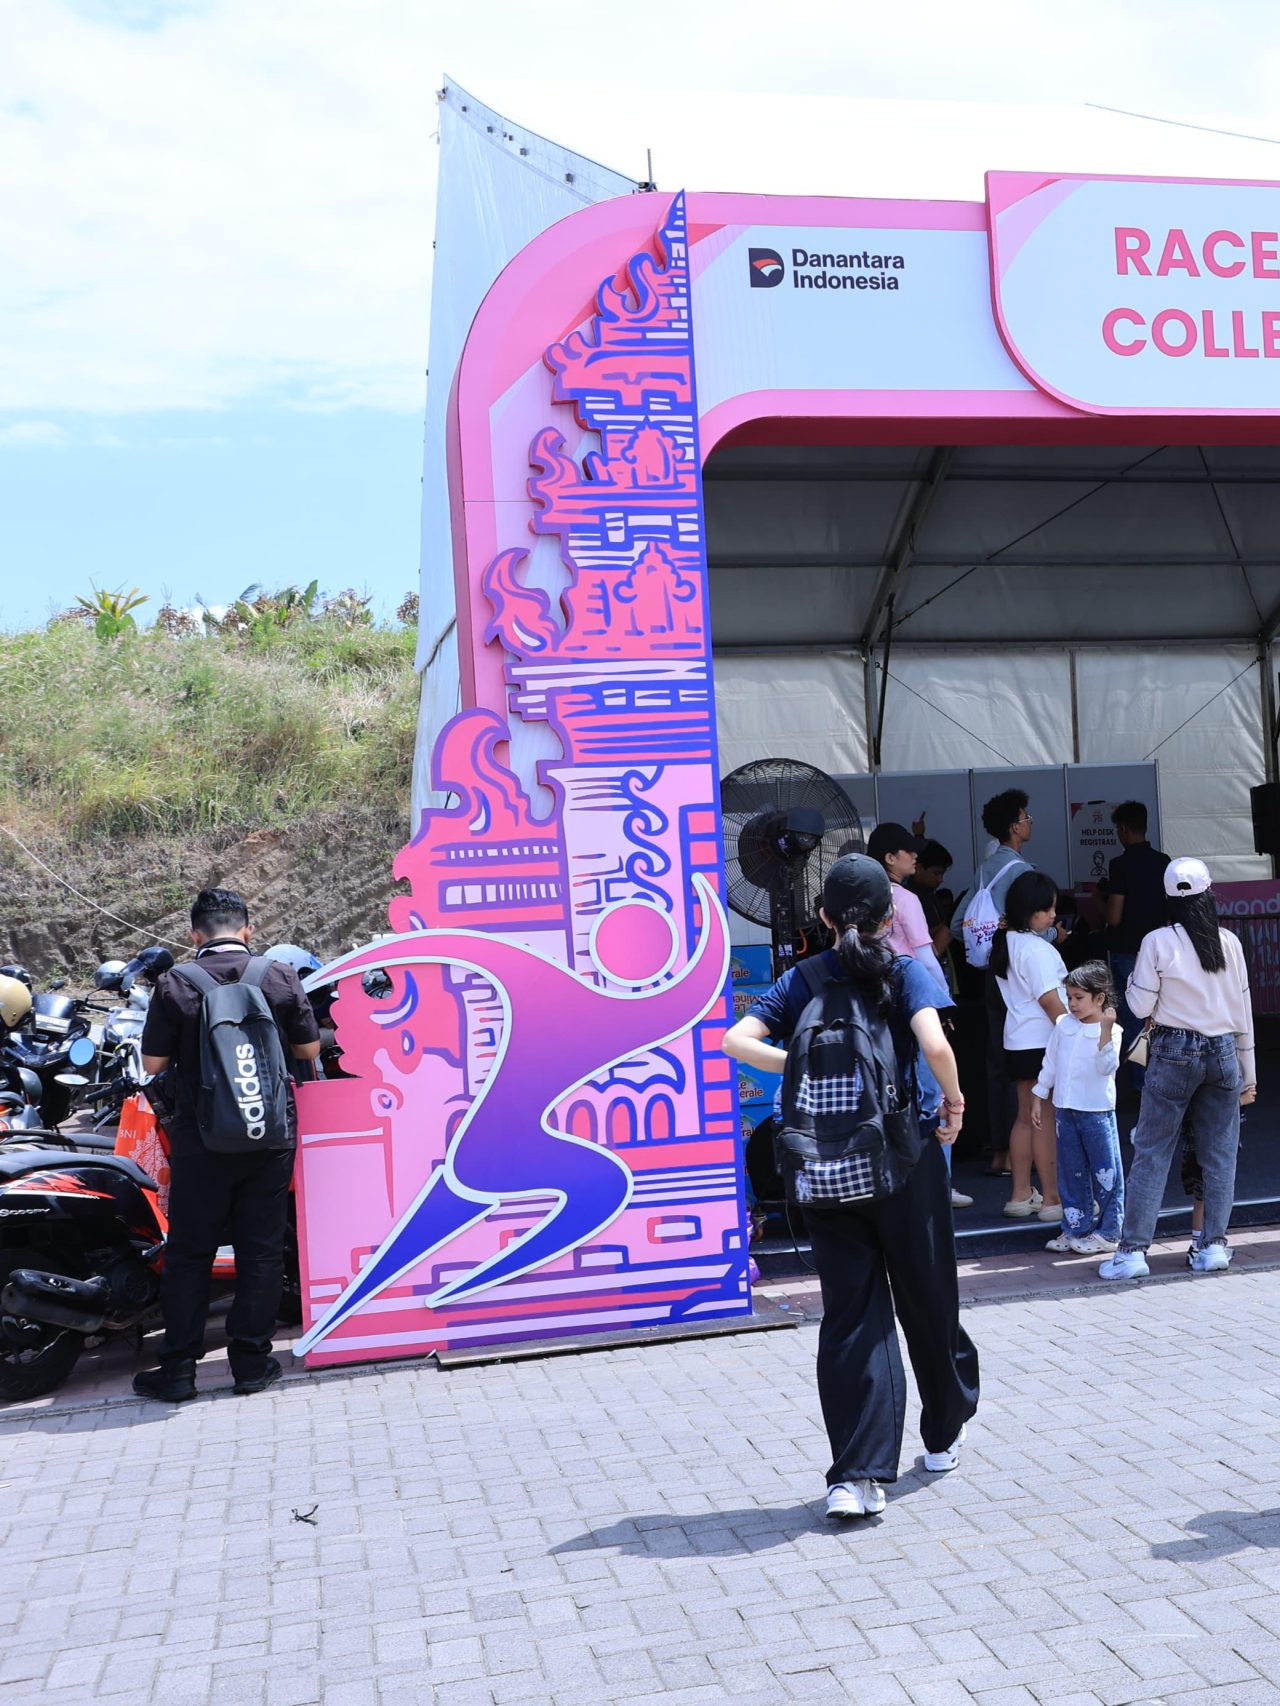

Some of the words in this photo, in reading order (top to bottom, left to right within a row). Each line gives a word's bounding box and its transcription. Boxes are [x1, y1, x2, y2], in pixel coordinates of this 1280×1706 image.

[792, 248, 905, 269] Danantara
[1114, 226, 1280, 279] RACE
[793, 270, 899, 290] Indonesia
[1079, 838, 1117, 846] REGISTRASI
[1081, 828, 1097, 836] HELP
[1097, 828, 1114, 836] DESK
[235, 1043, 266, 1140] adidas
